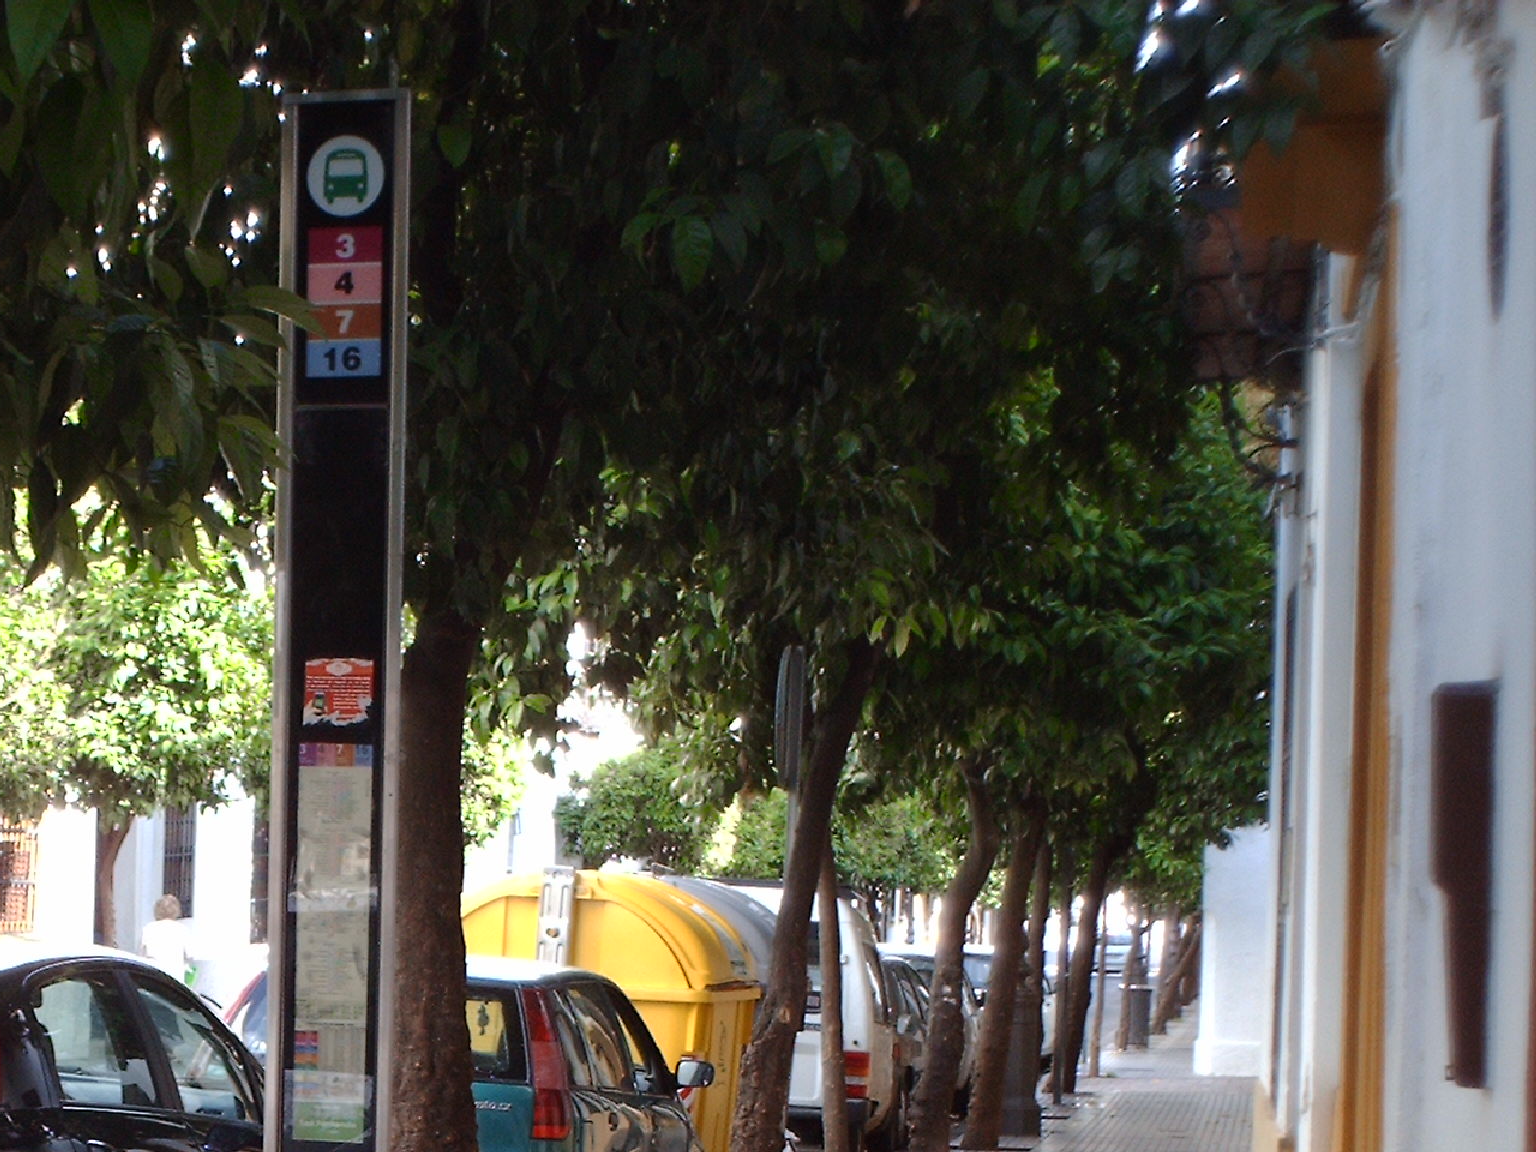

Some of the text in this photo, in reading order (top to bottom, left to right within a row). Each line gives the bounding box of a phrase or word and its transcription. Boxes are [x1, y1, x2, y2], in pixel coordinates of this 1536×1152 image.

[335, 233, 355, 258] 3
[334, 271, 354, 294] 4
[335, 309, 354, 334] 7
[323, 346, 361, 371] 16
